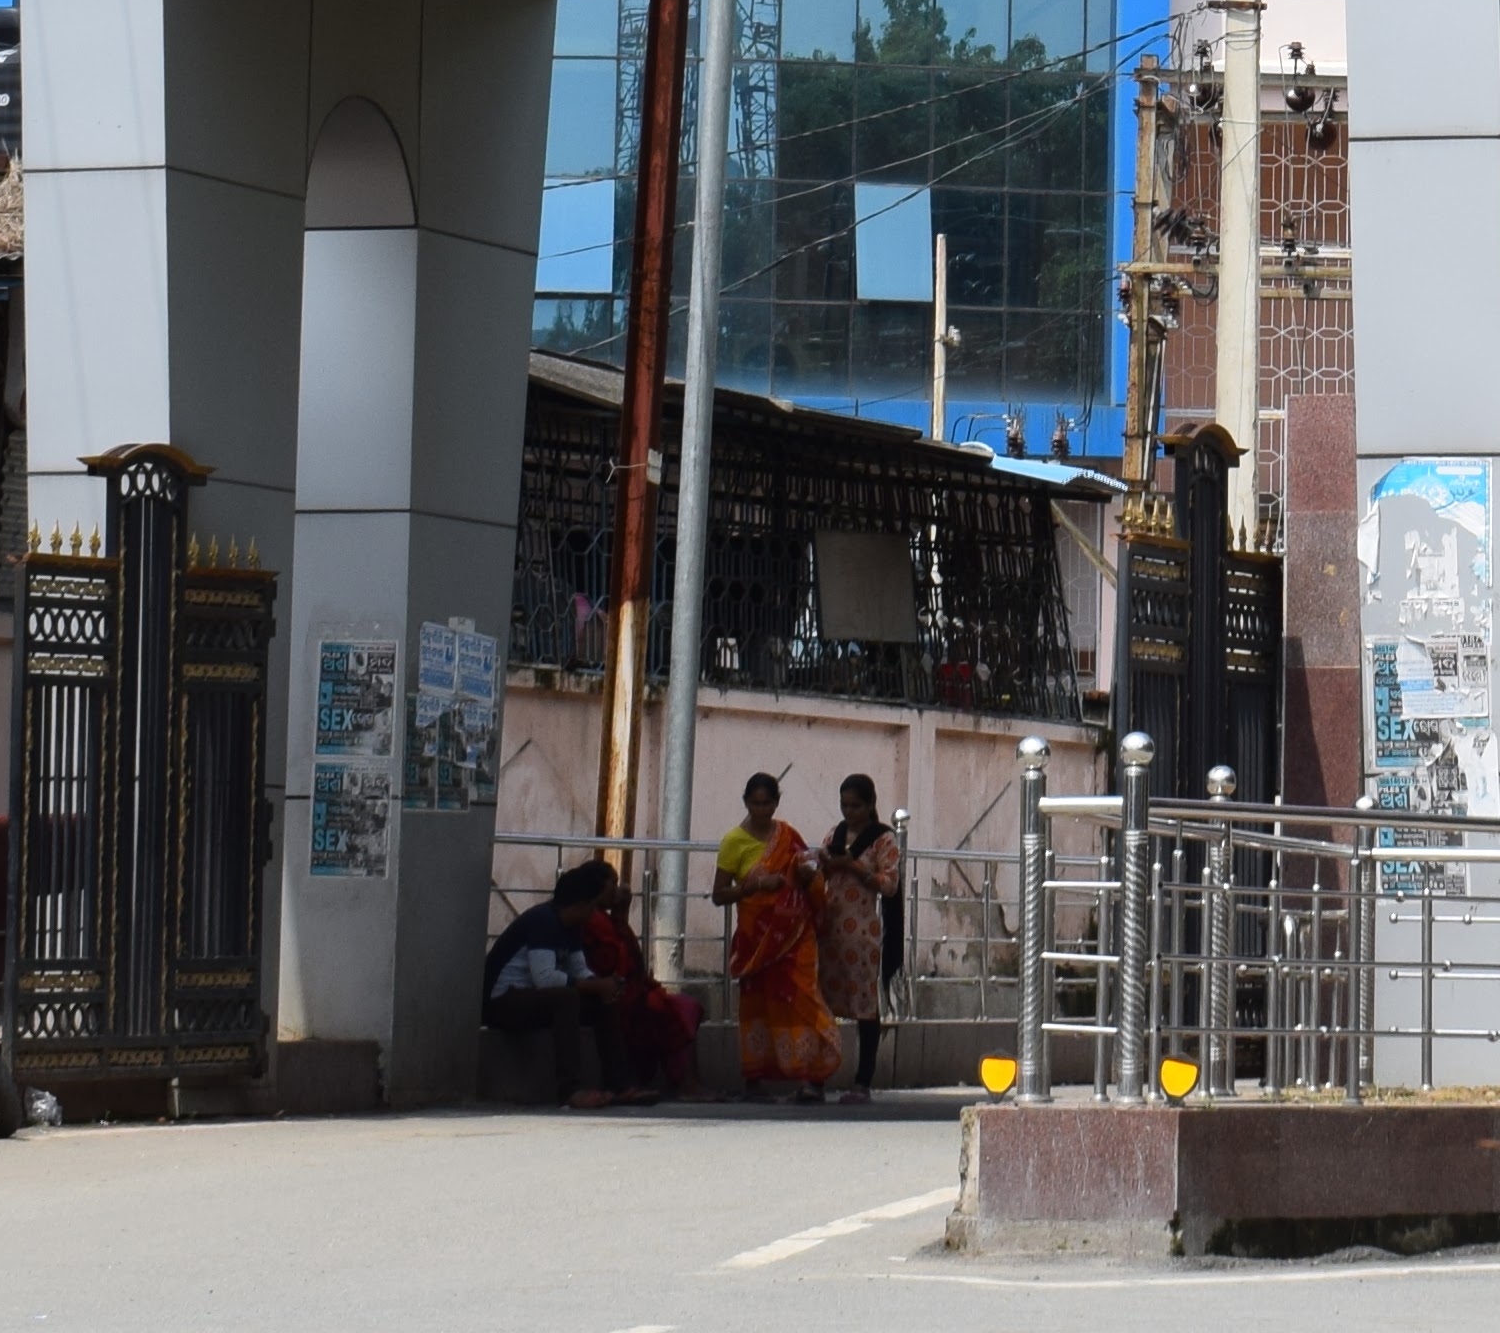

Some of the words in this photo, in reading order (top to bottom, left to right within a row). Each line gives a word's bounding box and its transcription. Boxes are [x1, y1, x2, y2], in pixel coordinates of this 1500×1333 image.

[320, 709, 353, 731] SEX
[1377, 715, 1416, 741] SEX
[315, 829, 349, 852] SEX
